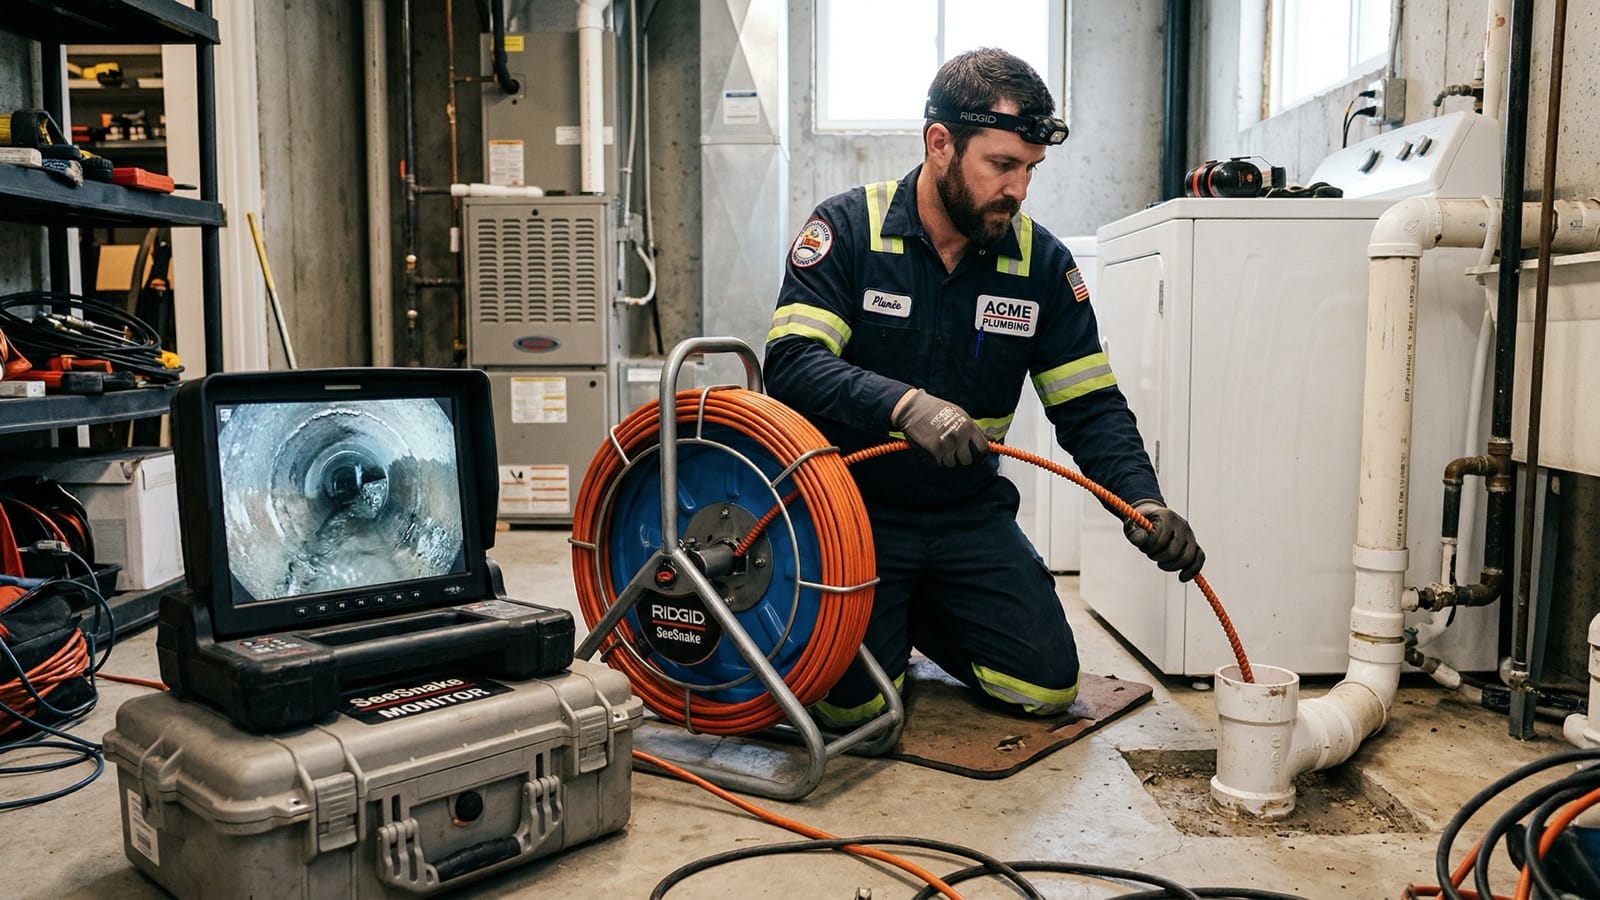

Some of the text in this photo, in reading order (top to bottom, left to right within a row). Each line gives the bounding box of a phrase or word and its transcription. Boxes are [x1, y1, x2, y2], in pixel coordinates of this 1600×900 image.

[960, 112, 997, 124] RIDGID
[984, 301, 1033, 319] ACME
[982, 317, 1030, 332] PLUMBING
[652, 604, 705, 625] RIDGID
[656, 626, 701, 644] SeeSnake
[350, 678, 465, 708] SeeSnake
[377, 688, 491, 719] MONITOR
